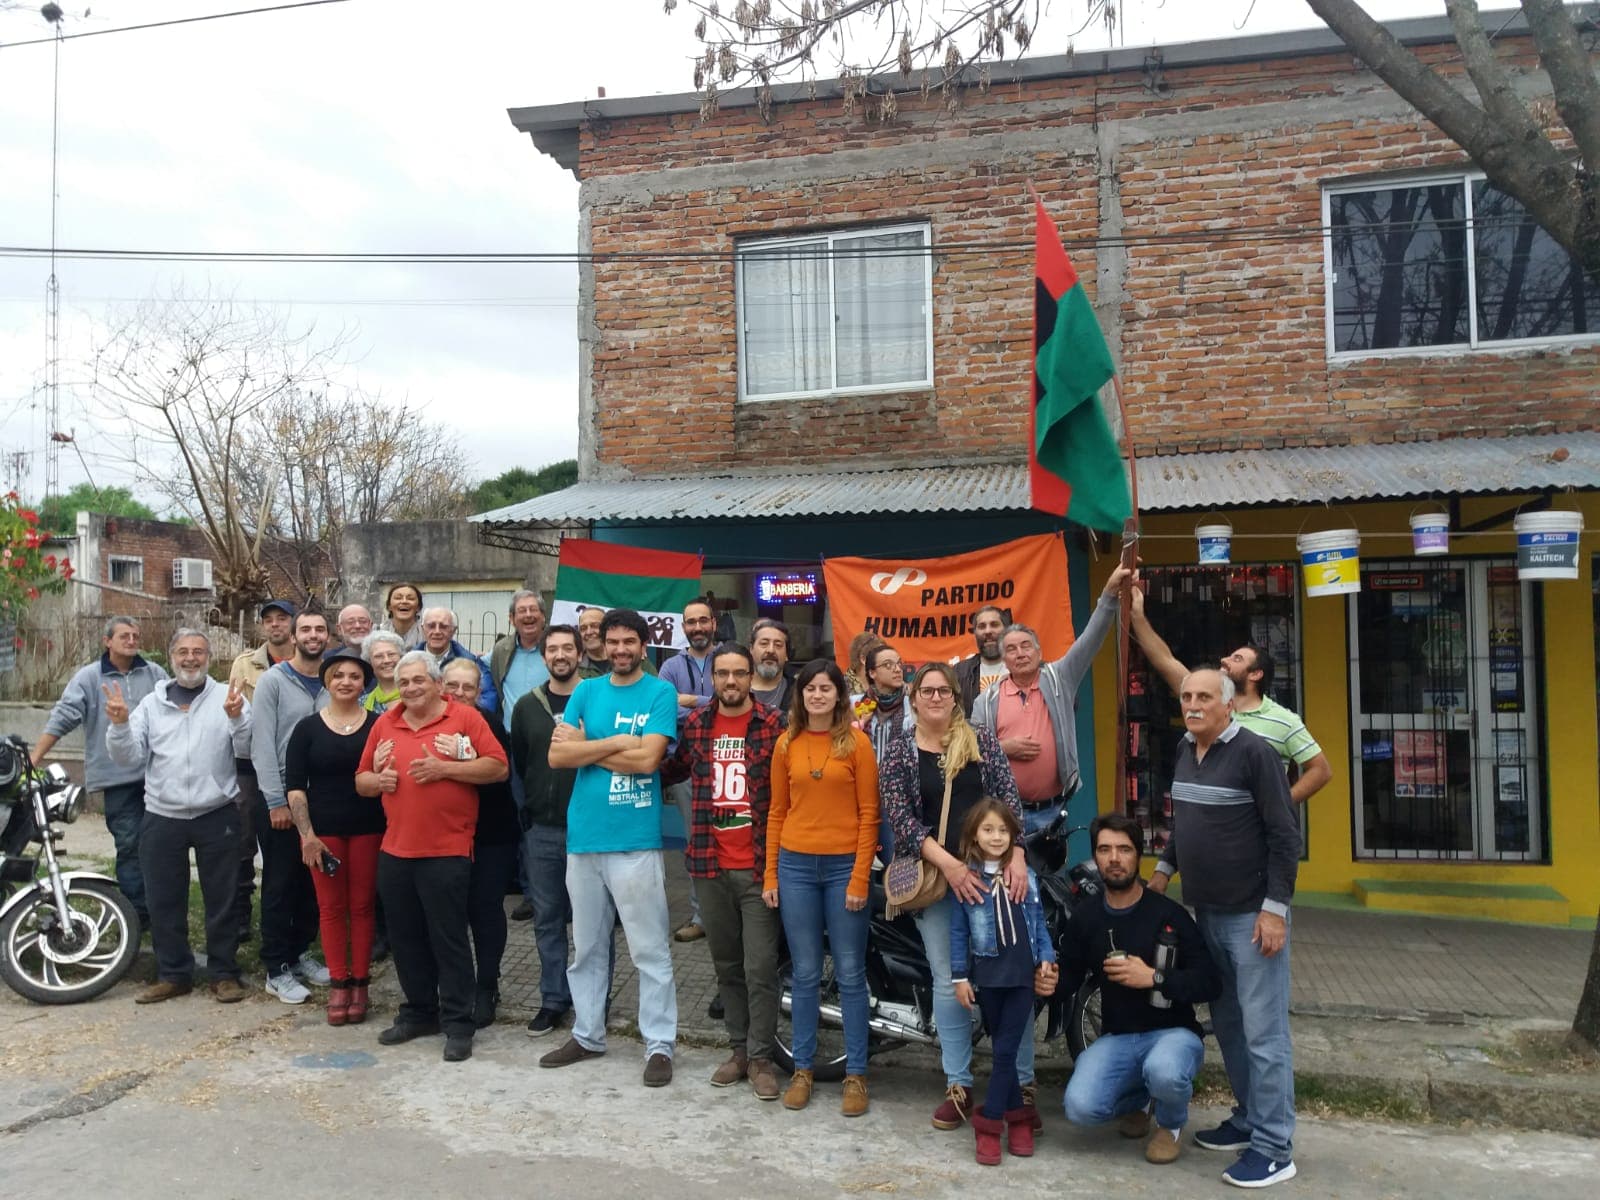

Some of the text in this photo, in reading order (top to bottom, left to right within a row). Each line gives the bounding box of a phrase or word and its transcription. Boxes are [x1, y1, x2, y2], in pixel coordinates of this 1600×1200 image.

[771, 582, 815, 596] BARBERIA
[921, 579, 1014, 606] PARTIDO
[864, 607, 1013, 639] HUMANIS
[713, 739, 746, 749] PUEBL
[718, 750, 746, 759] LUCH
